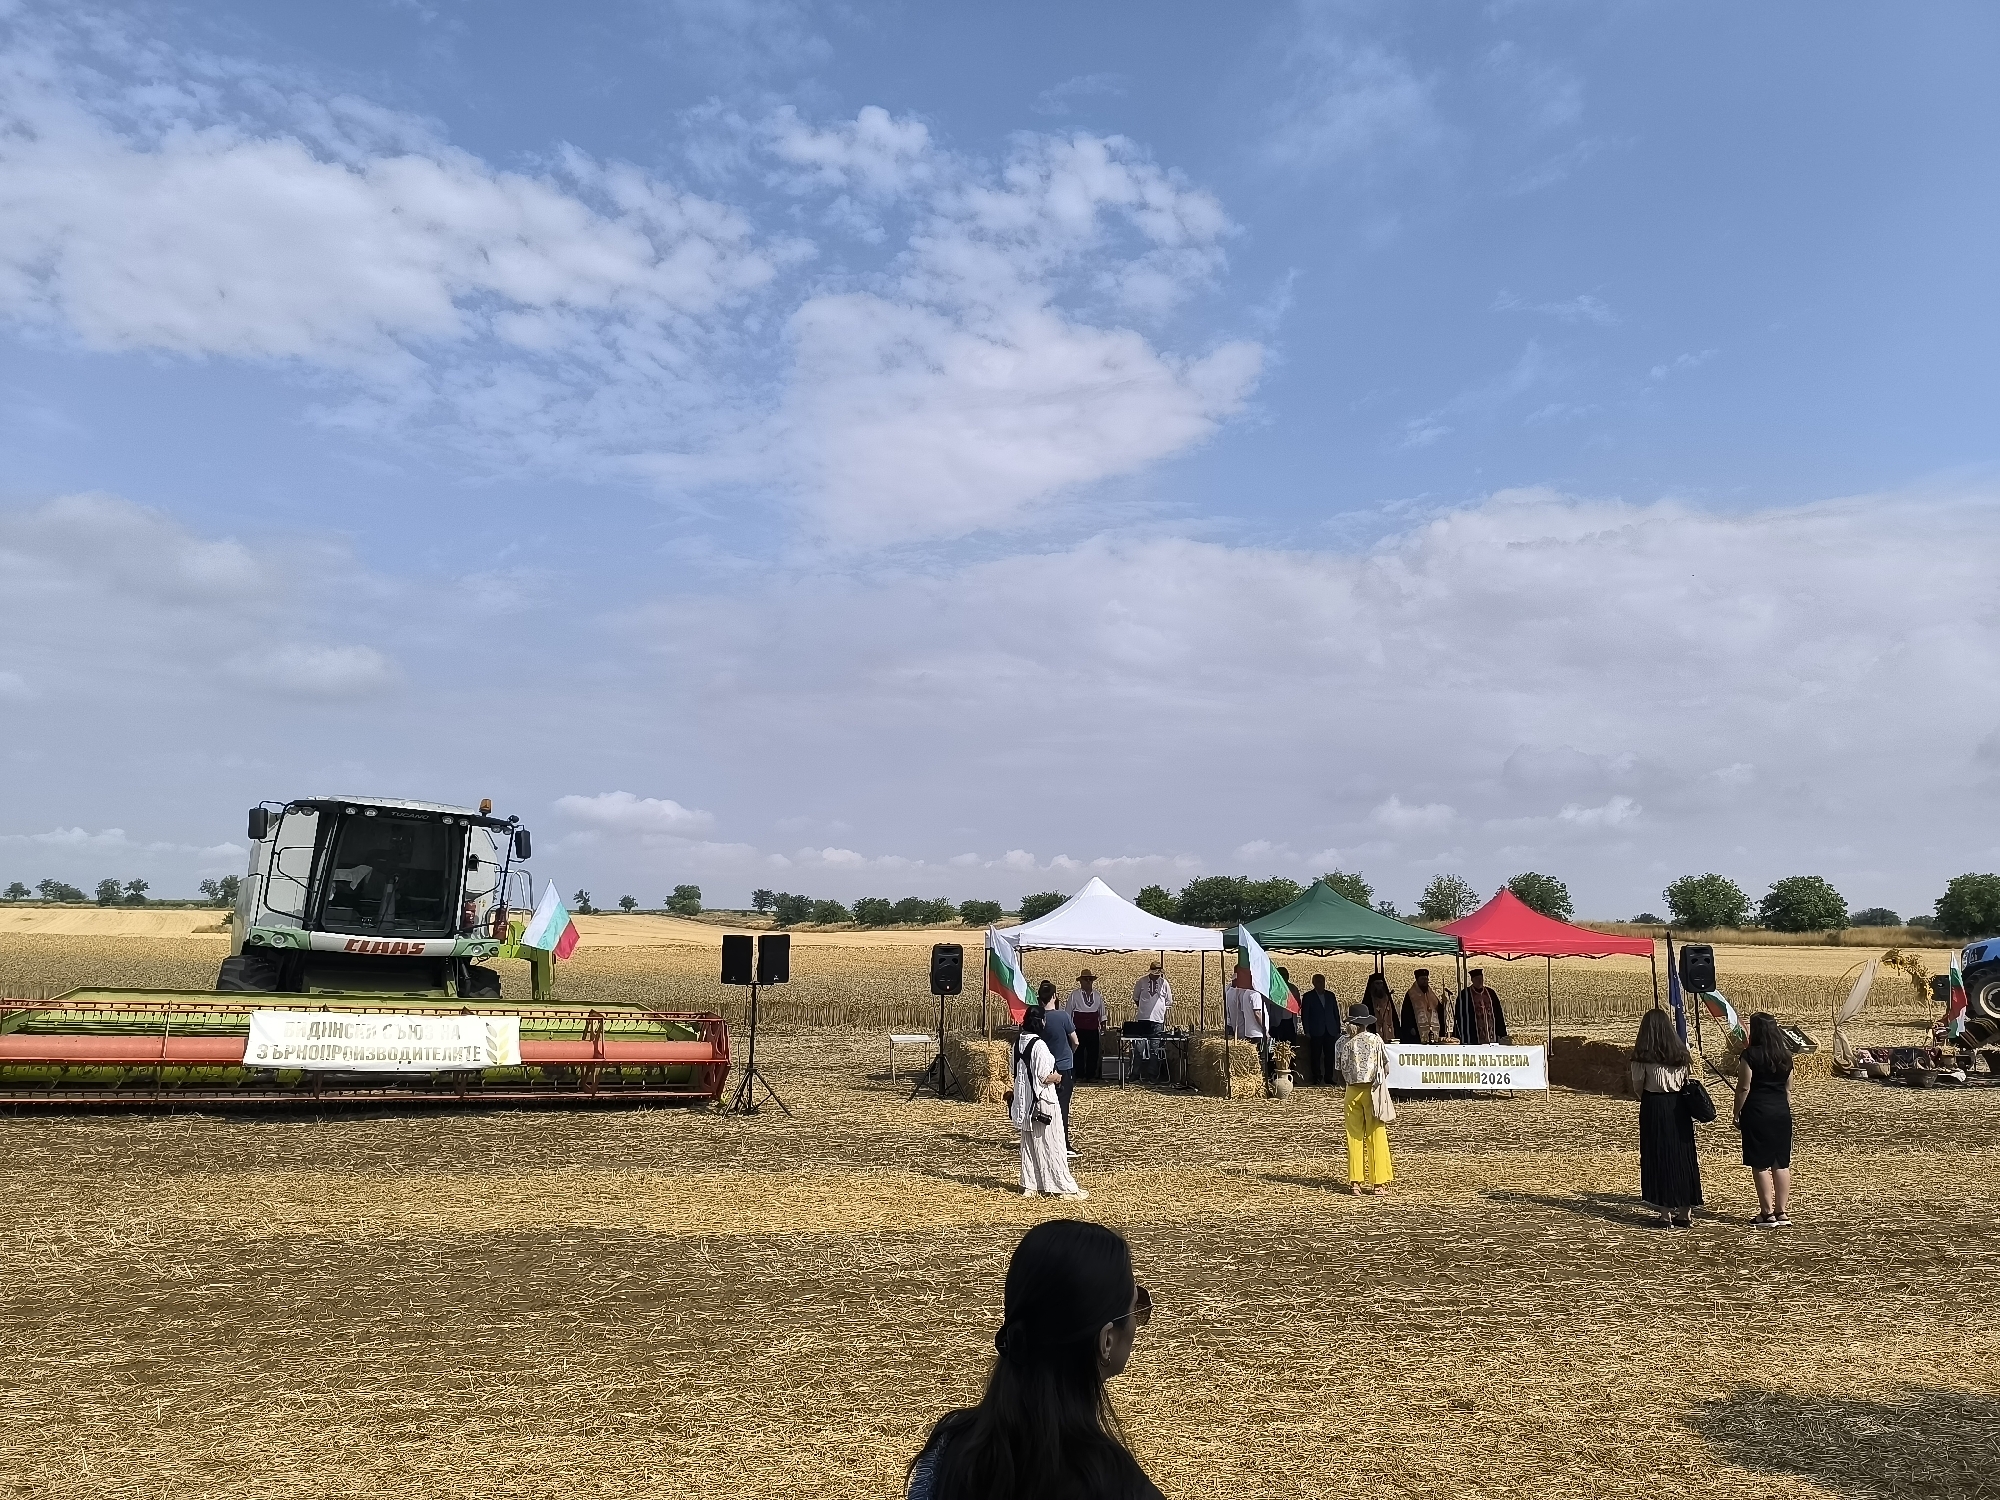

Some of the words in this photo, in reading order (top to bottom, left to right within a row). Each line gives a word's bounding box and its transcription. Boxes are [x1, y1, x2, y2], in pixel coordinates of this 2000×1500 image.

[391, 811, 430, 820] TUCANO
[343, 938, 426, 955] CLAAS
[382, 1023, 434, 1041] СЪЮЗ
[441, 1024, 461, 1040] НА
[256, 1043, 481, 1065] ЗЪРНОПРОИЗВОДИТЕЛИТЕ
[1398, 1053, 1460, 1067] ОТКРИВАНЕ
[1462, 1053, 1477, 1067] НА
[1478, 1054, 1530, 1067] ЖЪТВЕНА
